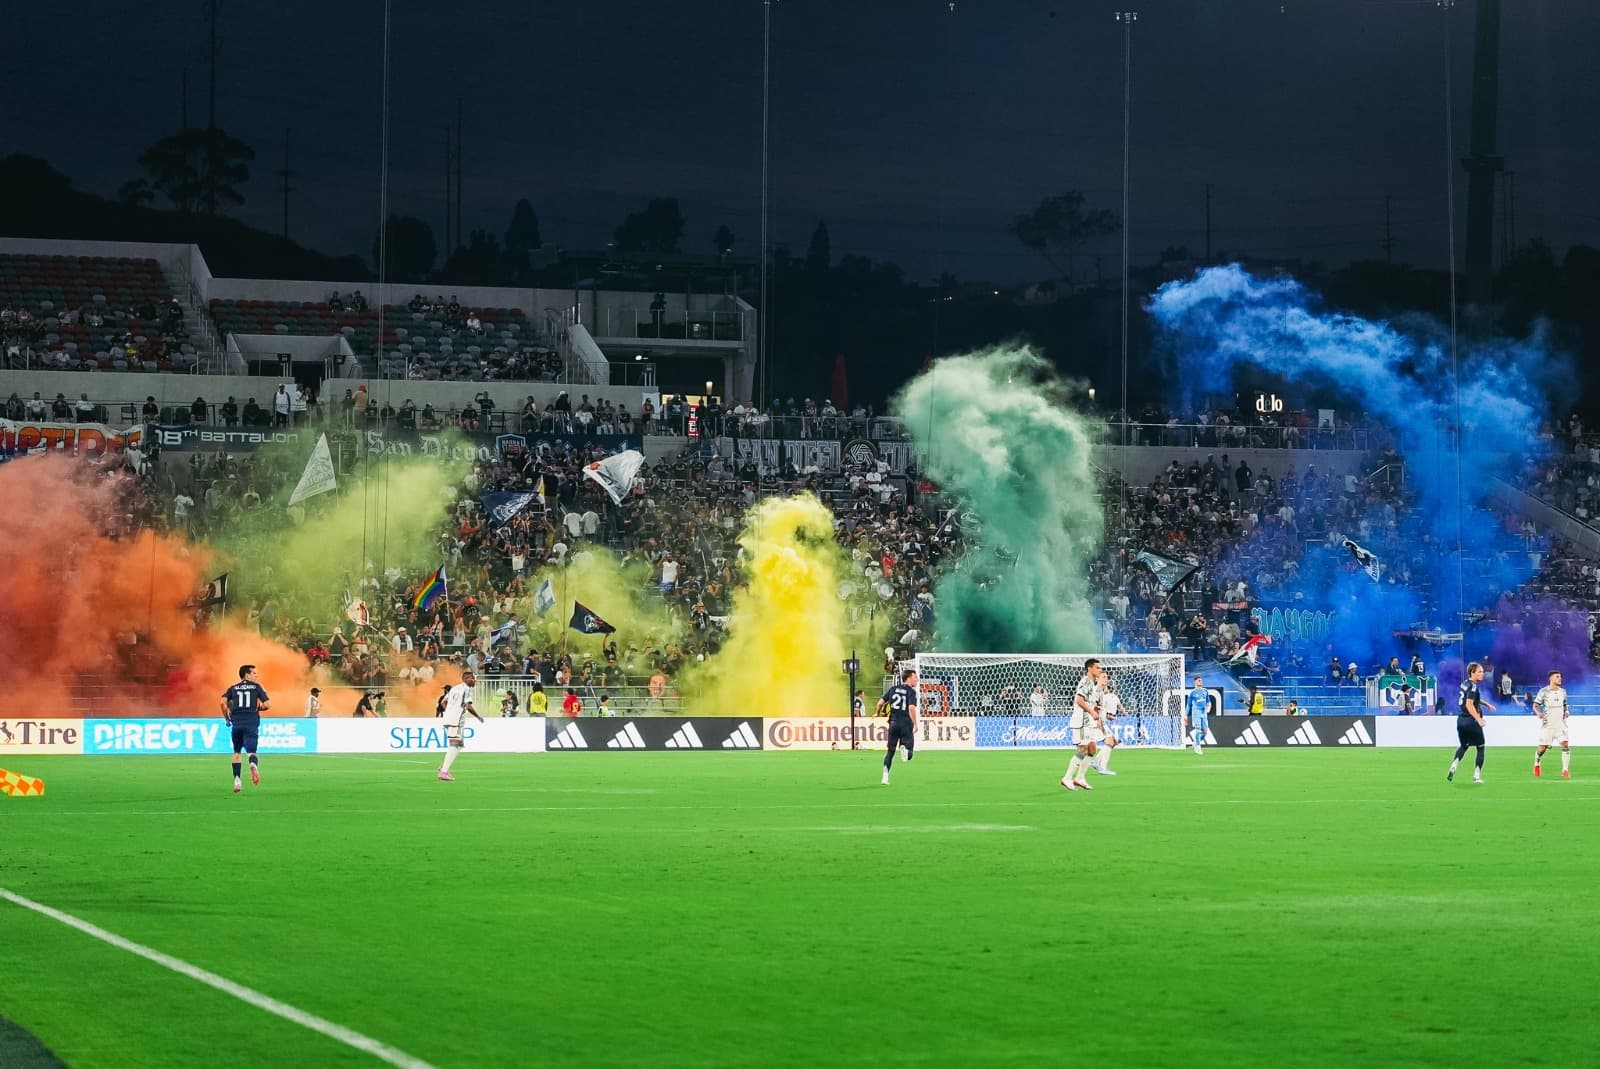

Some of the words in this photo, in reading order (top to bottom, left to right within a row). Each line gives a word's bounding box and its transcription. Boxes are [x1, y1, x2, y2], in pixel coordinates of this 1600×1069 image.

[236, 691, 251, 708] 11
[891, 693, 907, 711] 21
[15, 721, 77, 745] Tire
[94, 723, 219, 749] DIRECTV
[263, 723, 297, 735] HOME
[768, 719, 889, 748] Continenta
[919, 719, 970, 741] Tire
[1111, 724, 1151, 740] TRA
